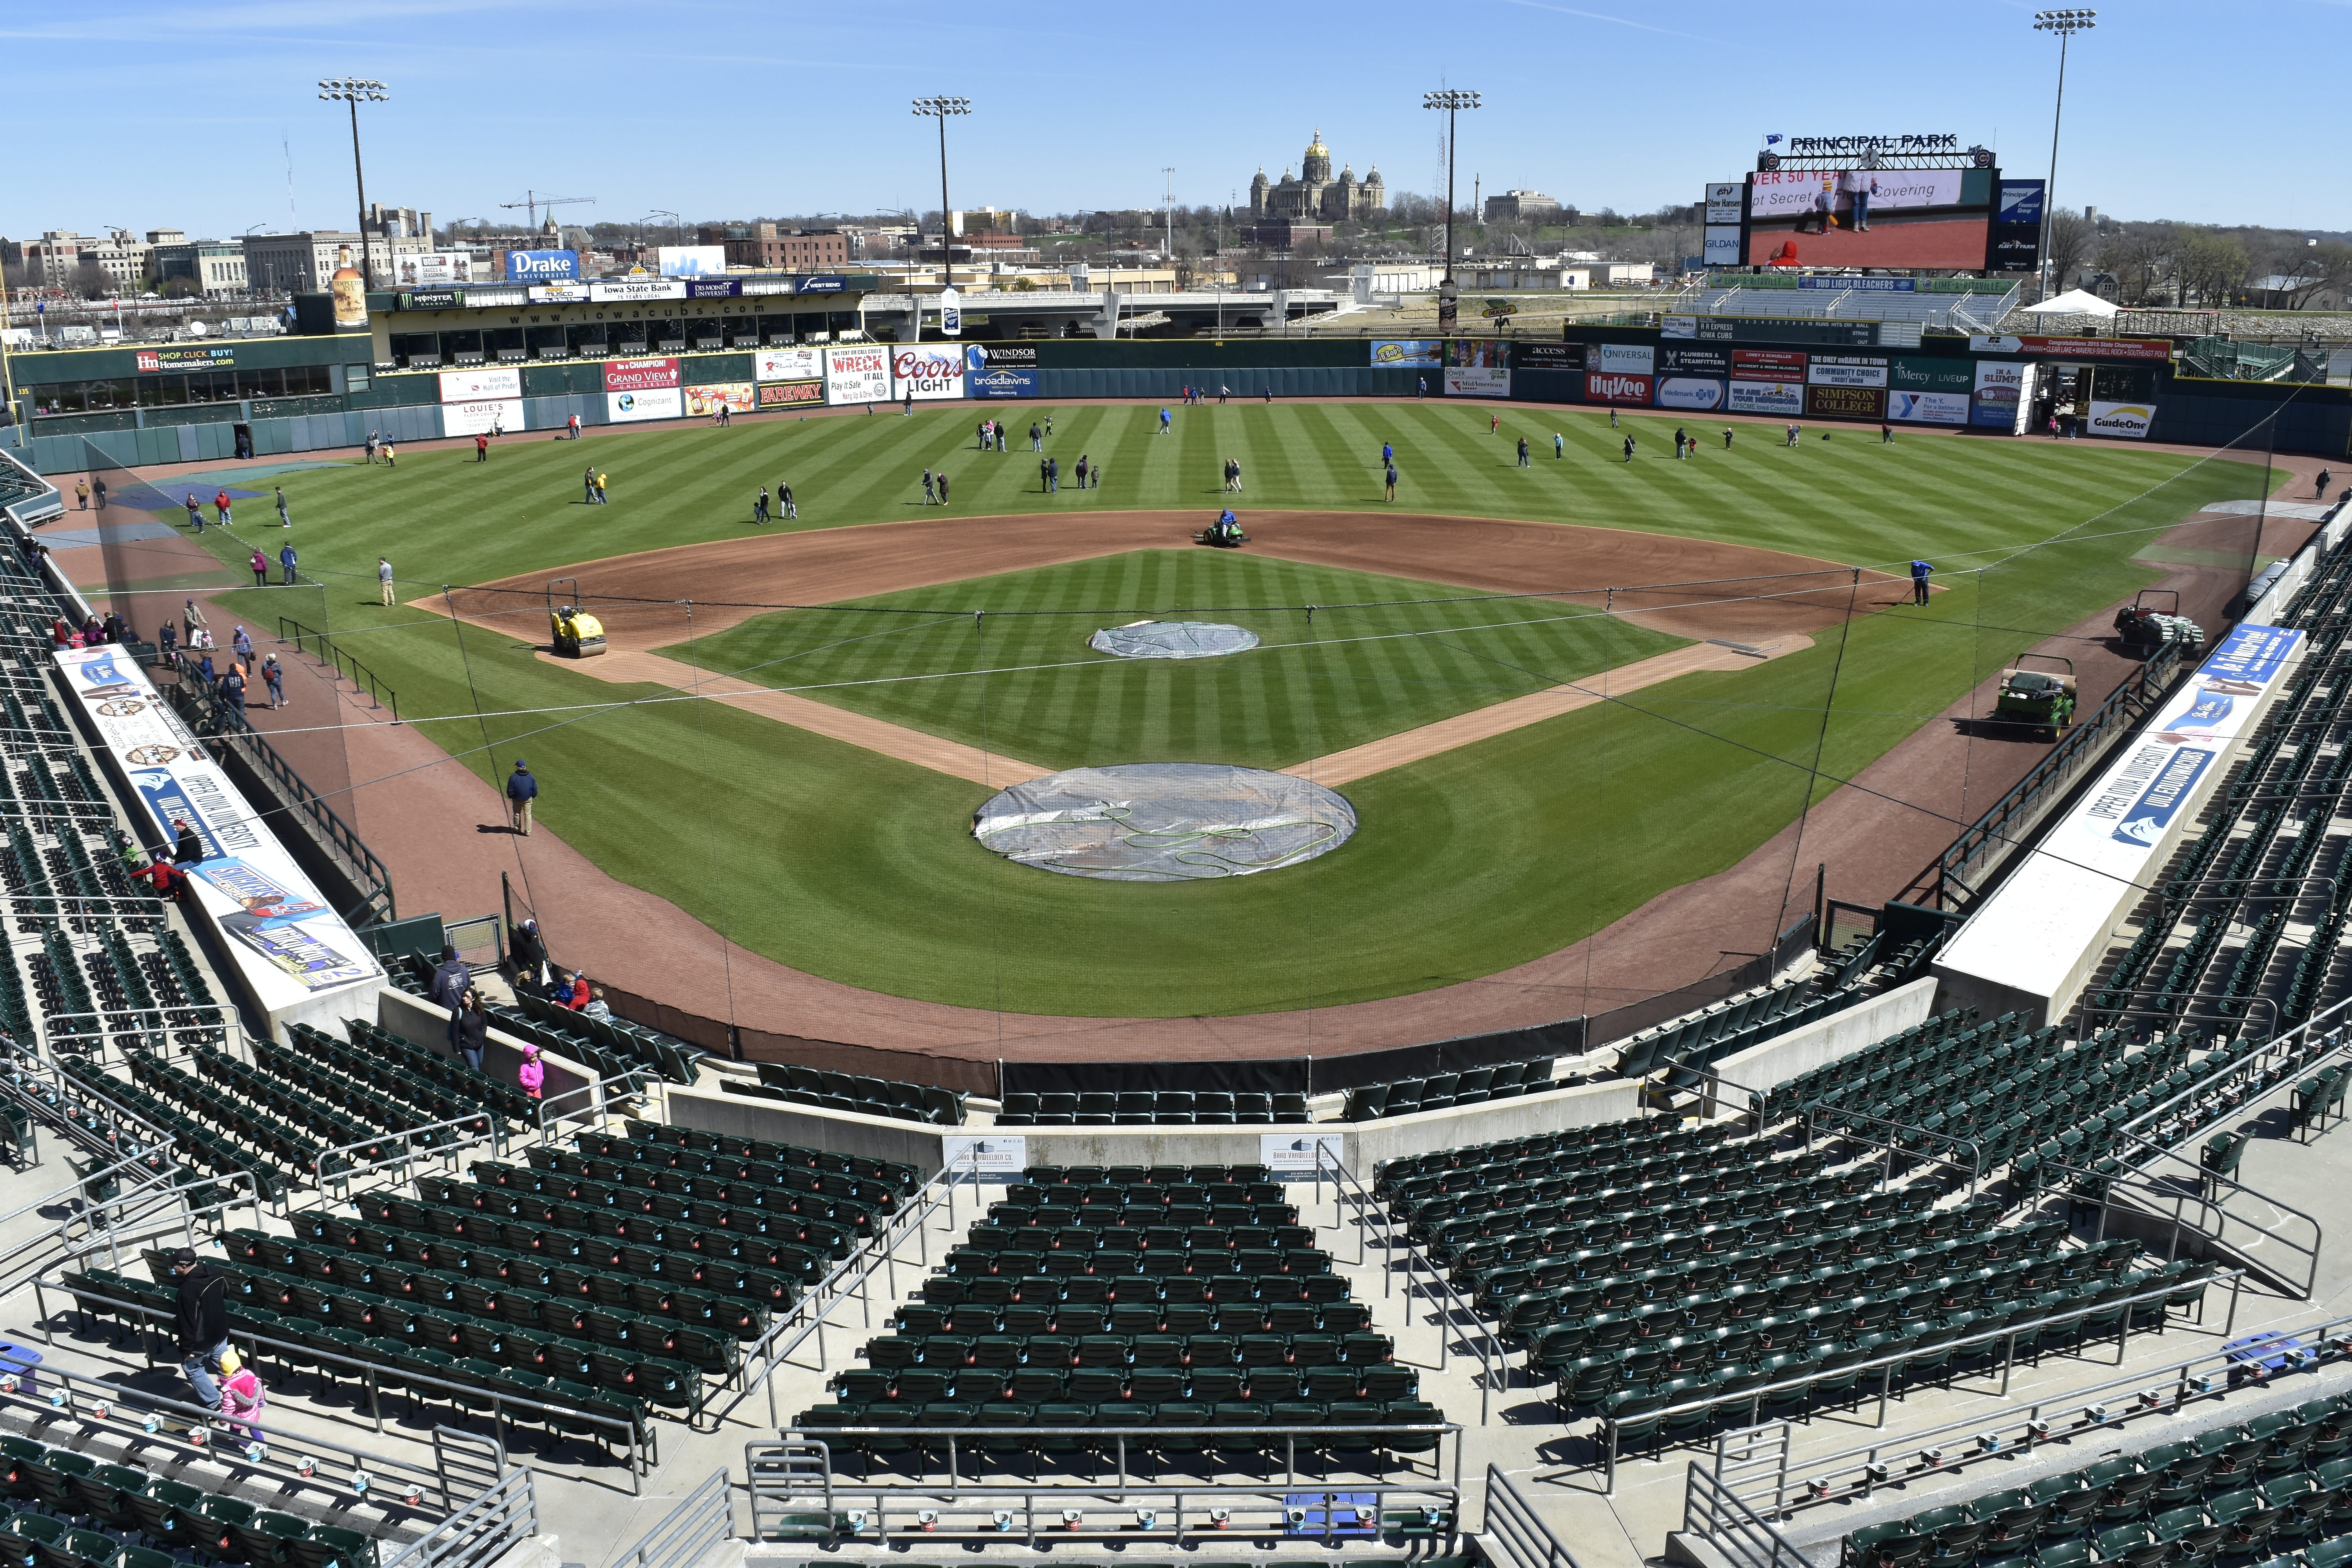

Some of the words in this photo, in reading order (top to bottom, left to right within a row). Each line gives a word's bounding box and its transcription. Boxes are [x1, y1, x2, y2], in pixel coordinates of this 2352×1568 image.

[1791, 136, 1894, 150] PRINCIPAL
[1902, 134, 1956, 148] PARK
[1788, 171, 1804, 183] 50
[1769, 192, 1811, 204] Secret
[1874, 184, 1935, 197] Covering
[512, 253, 571, 272] Drake
[1816, 279, 1829, 288] BUD
[1831, 279, 1851, 289] LIGHT
[1853, 279, 1893, 289] BLEACHERS
[989, 349, 1036, 359] WINDSOR
[1604, 349, 1651, 359] UNIVERSAL
[160, 359, 234, 368] Homemakers.com
[630, 360, 666, 368] CHAMPION!
[833, 355, 883, 373] WRECK
[894, 352, 963, 379] Coors
[608, 373, 642, 383] GRAND
[644, 371, 668, 380] VIEW
[1816, 367, 1855, 377] COMMUNITY
[1901, 370, 1930, 384] Mercy
[907, 379, 953, 392] LIGHT
[975, 375, 1030, 385] broadlawns
[1984, 375, 2022, 383] SLUMP?
[831, 382, 842, 391] Play
[760, 384, 821, 403] FAREWAY
[1817, 388, 1875, 401] SIMPSON
[638, 397, 671, 407] Cognizant
[1755, 397, 1799, 405] NEIGHBORS
[1816, 399, 1875, 412] COLLEGE
[464, 404, 503, 412] LOUIE'S
[2120, 744, 2171, 779] UNIVERSITY
[181, 774, 220, 795] UPPER
[2106, 779, 2145, 797] IOWA
[192, 793, 232, 812] IOWA
[2086, 795, 2131, 819] UPPER
[207, 810, 262, 850] UNIVERSITY
[215, 881, 253, 900] CRISPER
